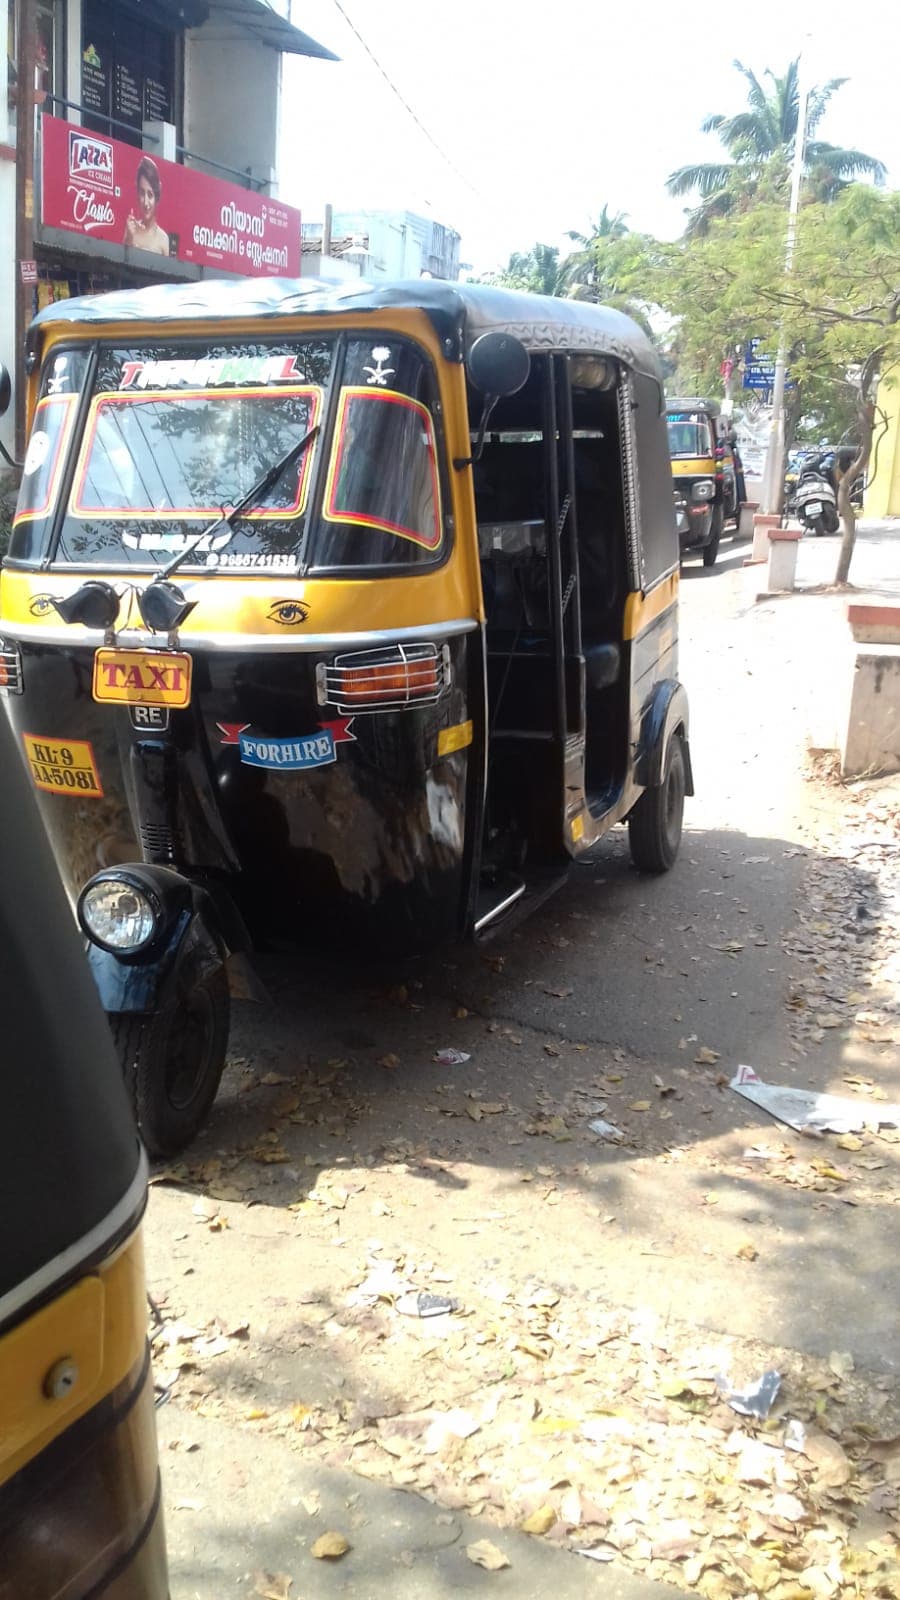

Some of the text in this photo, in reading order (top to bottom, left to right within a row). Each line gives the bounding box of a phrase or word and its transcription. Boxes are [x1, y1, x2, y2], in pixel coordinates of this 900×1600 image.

[73, 142, 108, 169] LAZZA
[67, 186, 114, 229] Classic
[221, 201, 267, 238] നിയാസ്
[102, 663, 183, 691] TAXI
[135, 706, 161, 723] RE
